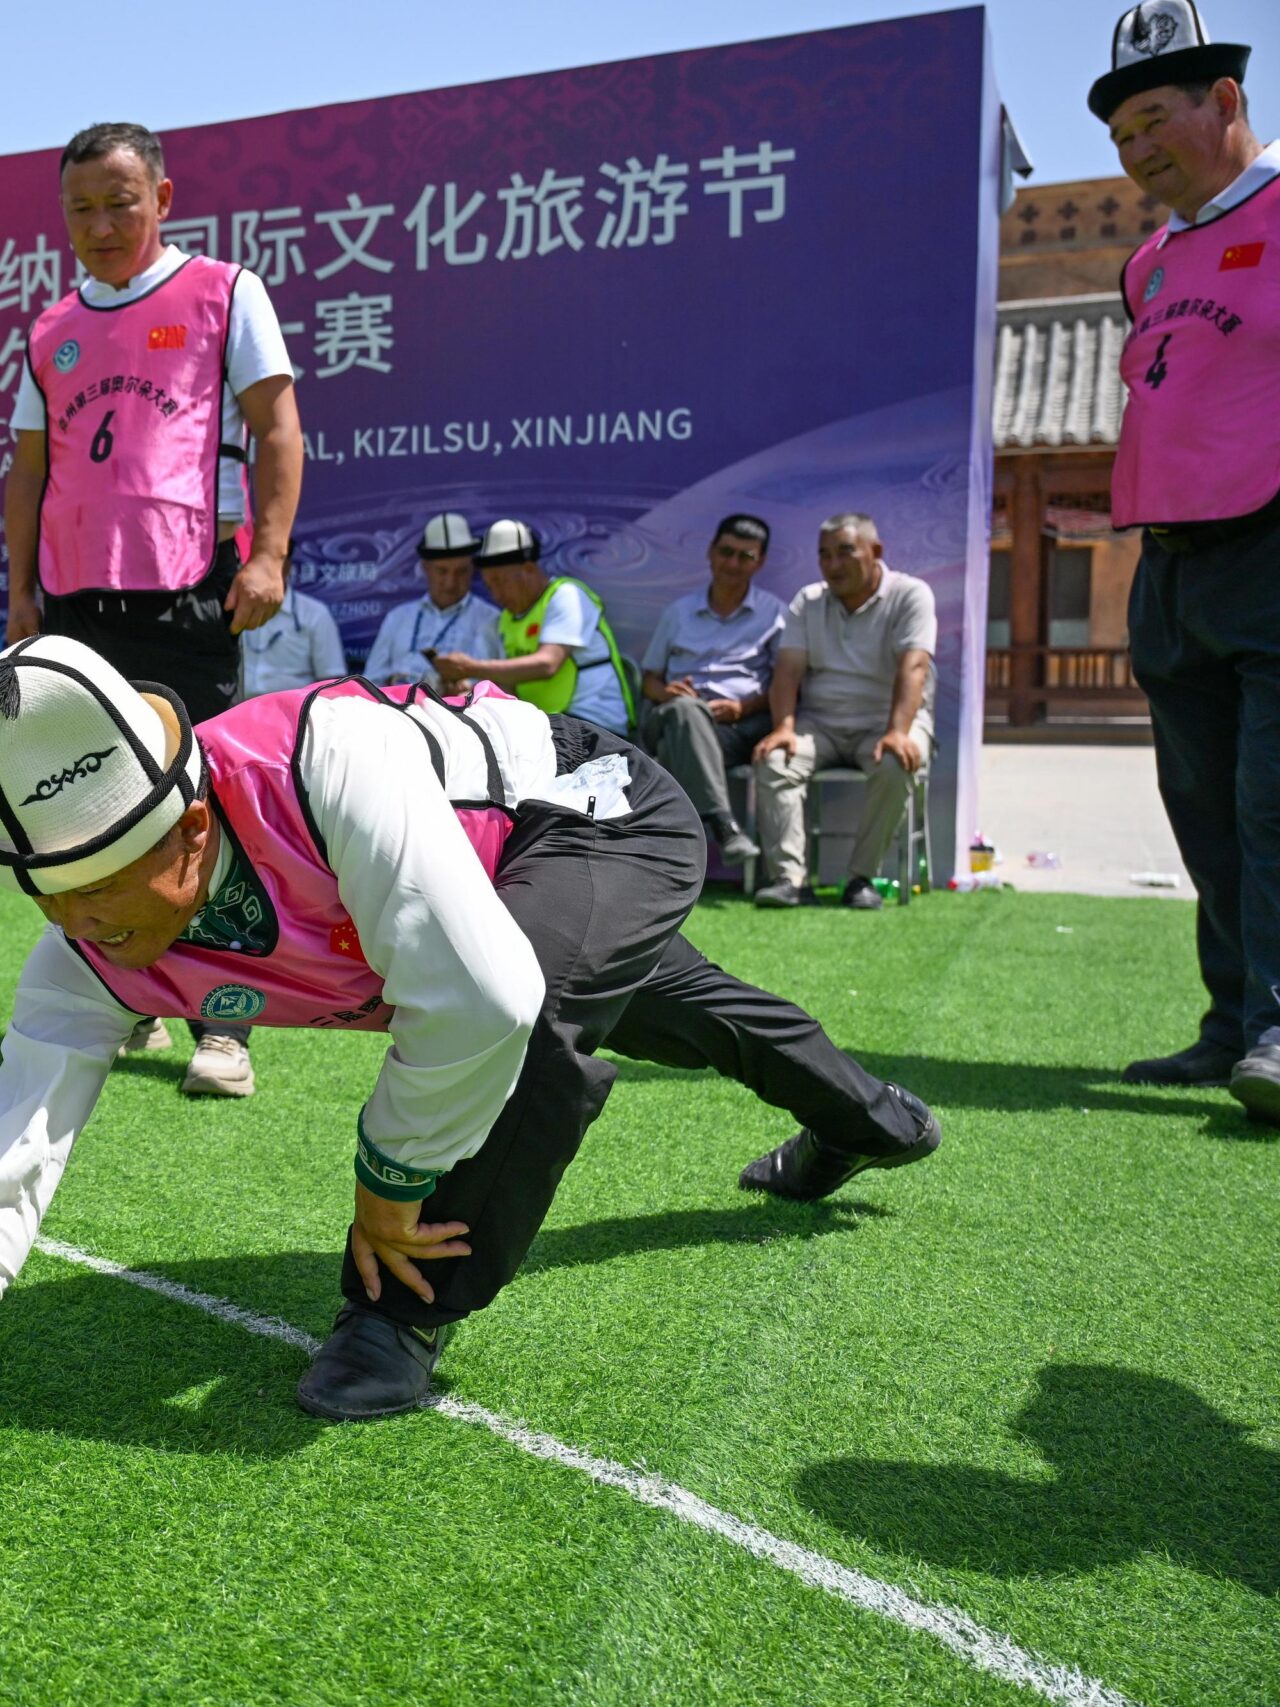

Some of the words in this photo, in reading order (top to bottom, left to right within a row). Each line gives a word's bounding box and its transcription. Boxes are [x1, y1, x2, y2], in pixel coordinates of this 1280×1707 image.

[1144, 333, 1173, 390] 4
[89, 410, 116, 464] 6
[353, 421, 503, 459] KIZILSU,
[510, 408, 695, 447] XINJIANG
